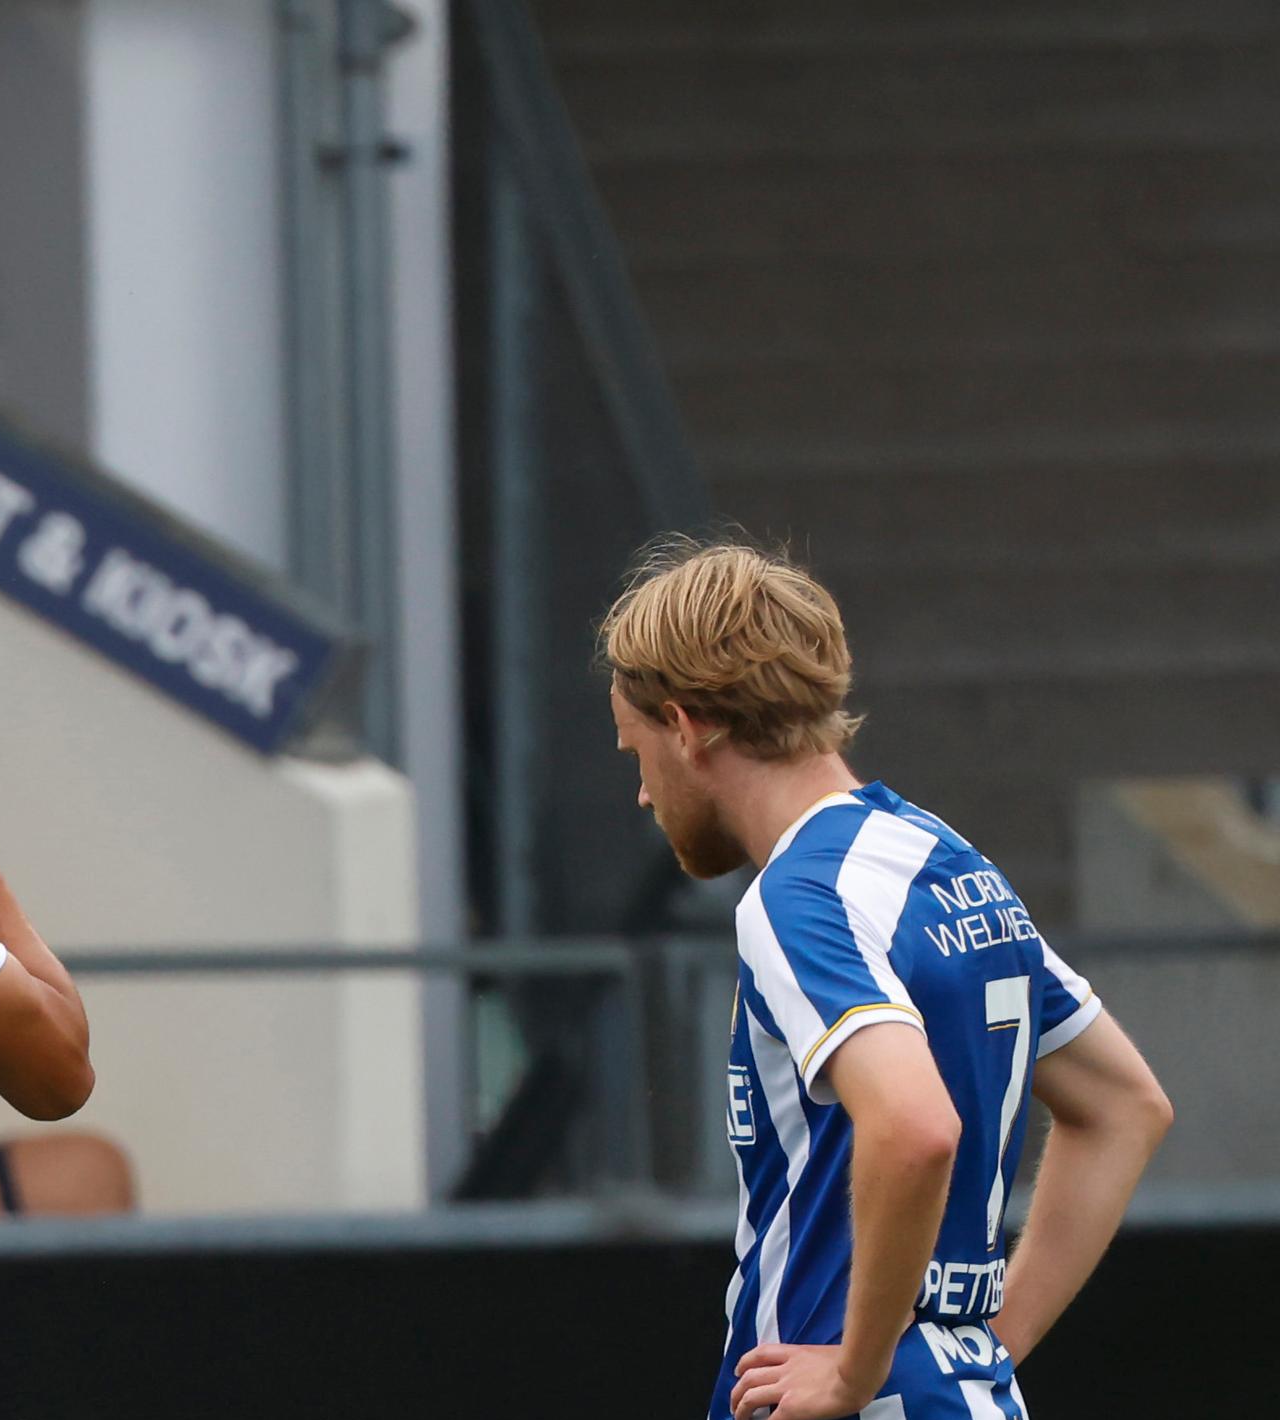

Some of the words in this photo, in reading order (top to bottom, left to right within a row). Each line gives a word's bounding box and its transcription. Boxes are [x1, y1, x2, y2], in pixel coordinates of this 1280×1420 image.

[16, 511, 88, 596] &
[84, 547, 302, 719] KIOSK
[985, 975, 1032, 1250] 7
